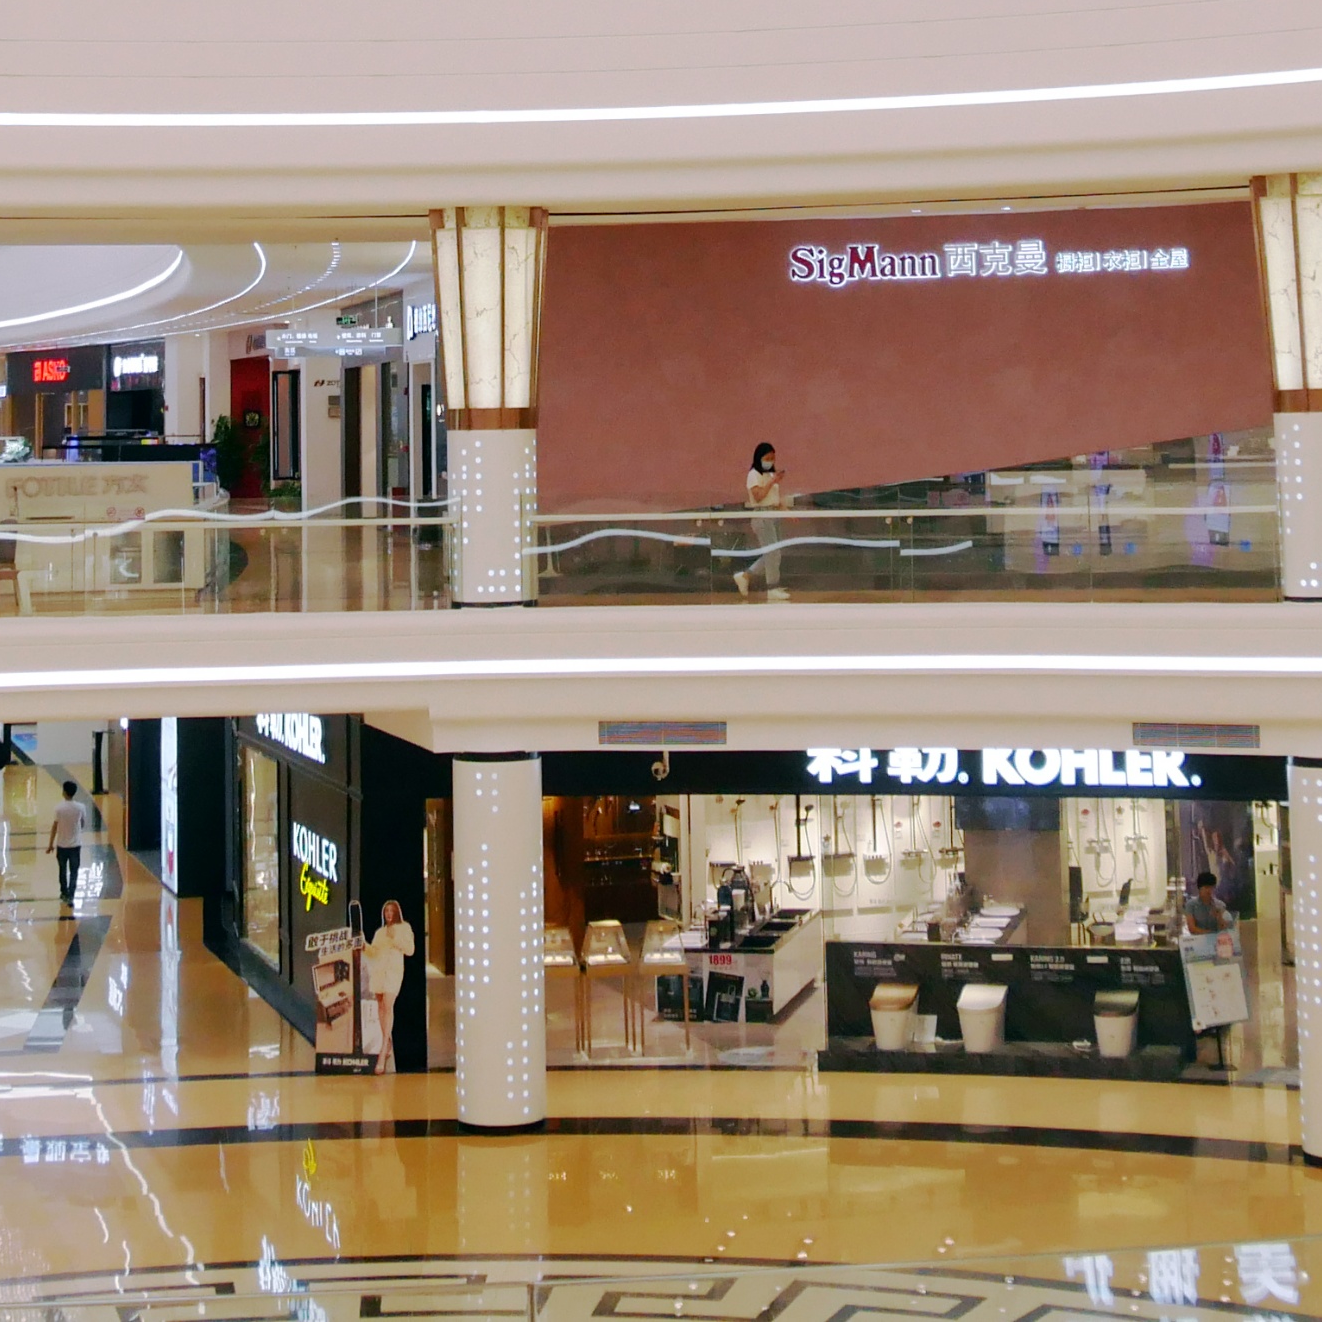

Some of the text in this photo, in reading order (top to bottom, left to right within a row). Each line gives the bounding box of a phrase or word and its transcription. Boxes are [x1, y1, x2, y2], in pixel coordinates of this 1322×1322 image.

[790, 245, 941, 285] SigMann
[944, 240, 1047, 276] 西克曼
[284, 713, 324, 763] KOHLER
[982, 749, 1191, 787] KOHLER
[292, 821, 339, 883] KOHLER
[709, 954, 732, 965] 1899
